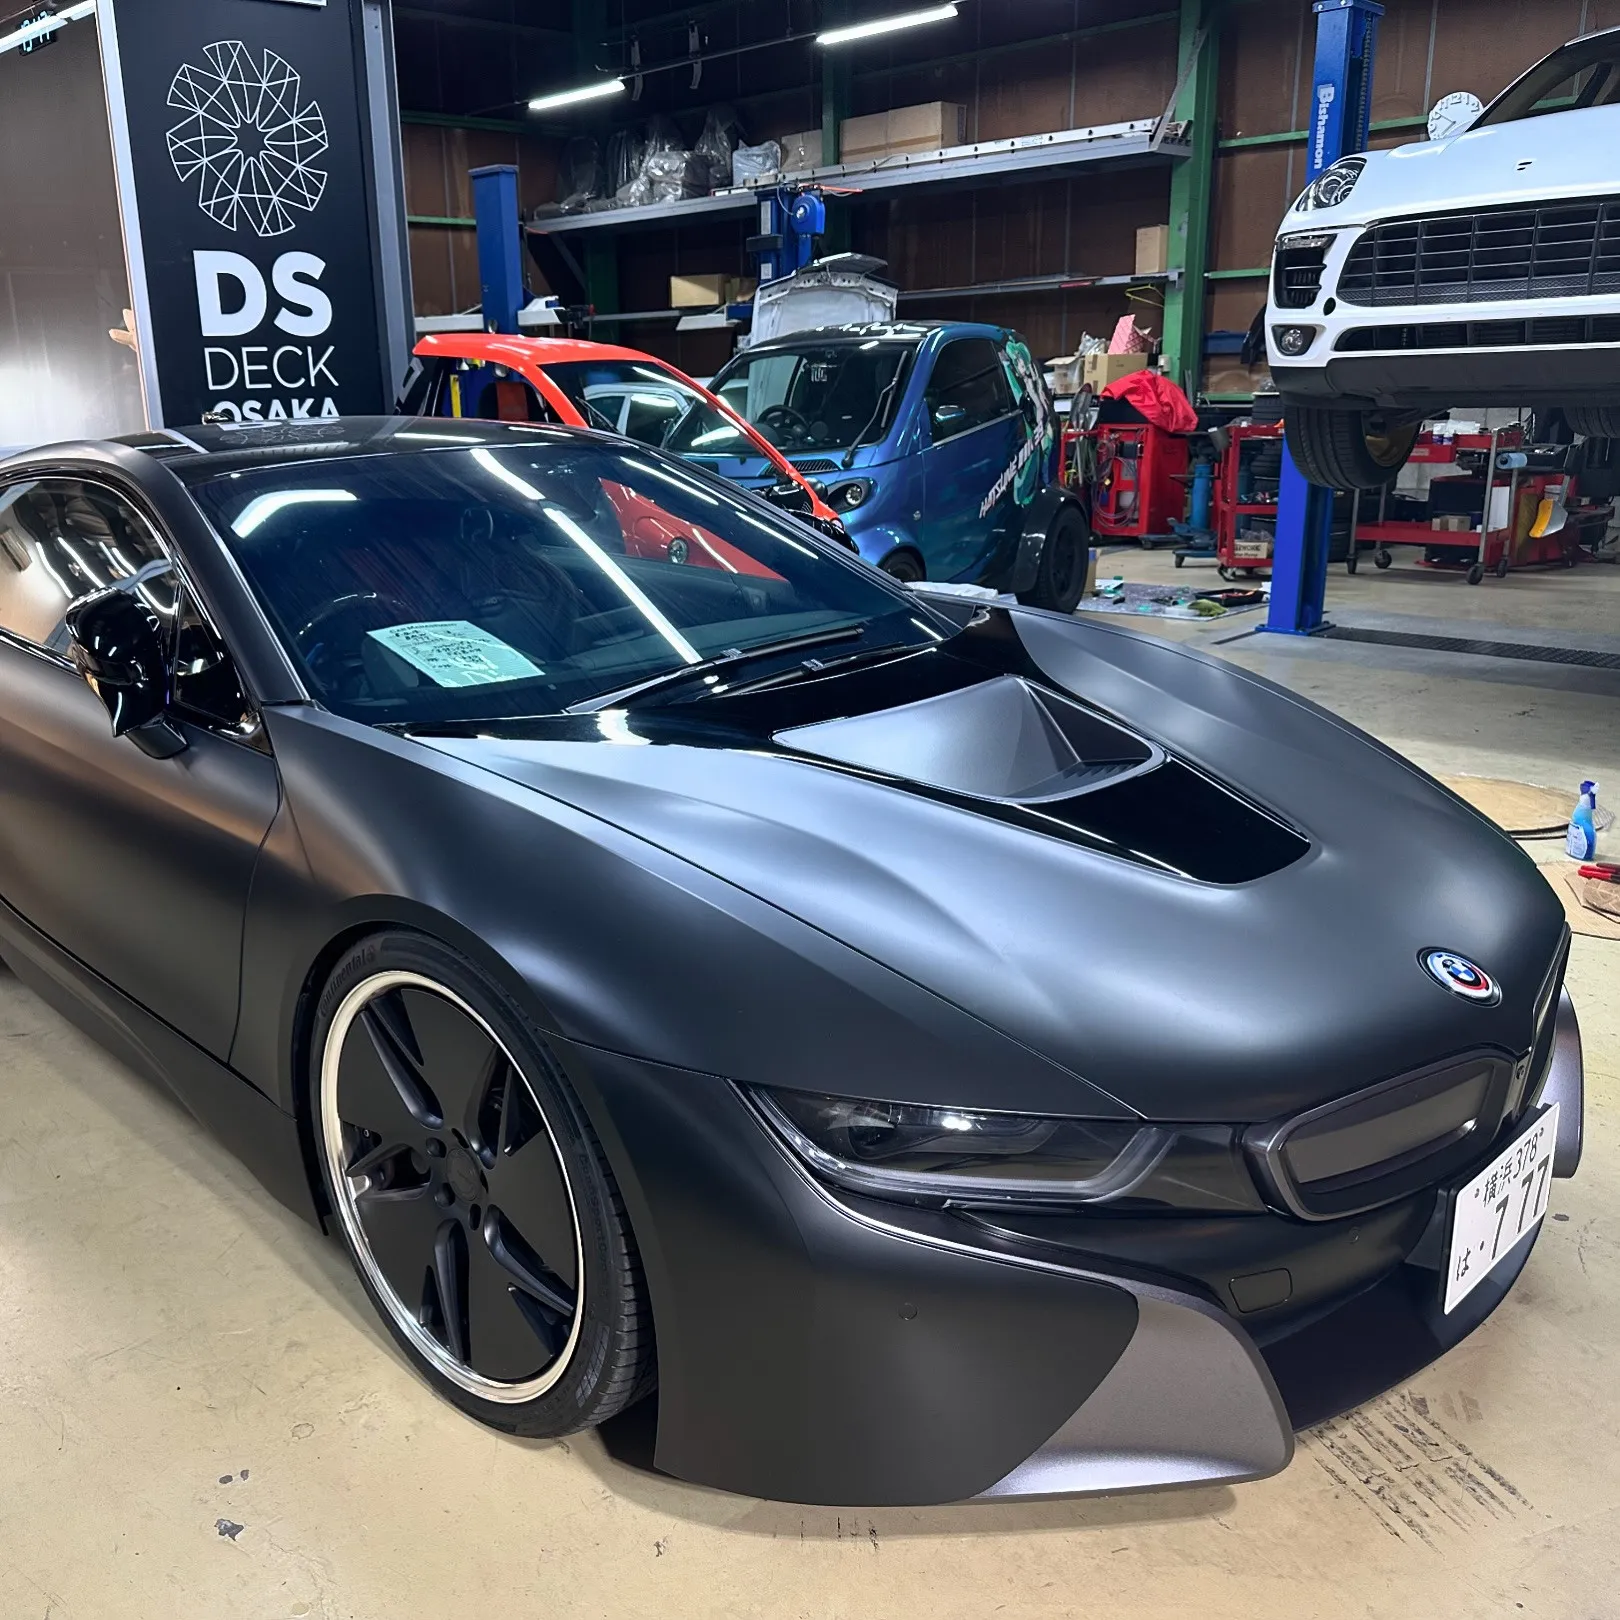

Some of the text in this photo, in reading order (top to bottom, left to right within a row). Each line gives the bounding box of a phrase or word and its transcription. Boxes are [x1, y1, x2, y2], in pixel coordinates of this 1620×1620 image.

[1313, 84, 1335, 170] Bishamon
[193, 250, 333, 337] DS
[204, 345, 340, 391] DECK
[211, 397, 341, 423] OSAKA
[1483, 1135, 1537, 1207] 横浜 378
[1456, 1248, 1471, 1281] は
